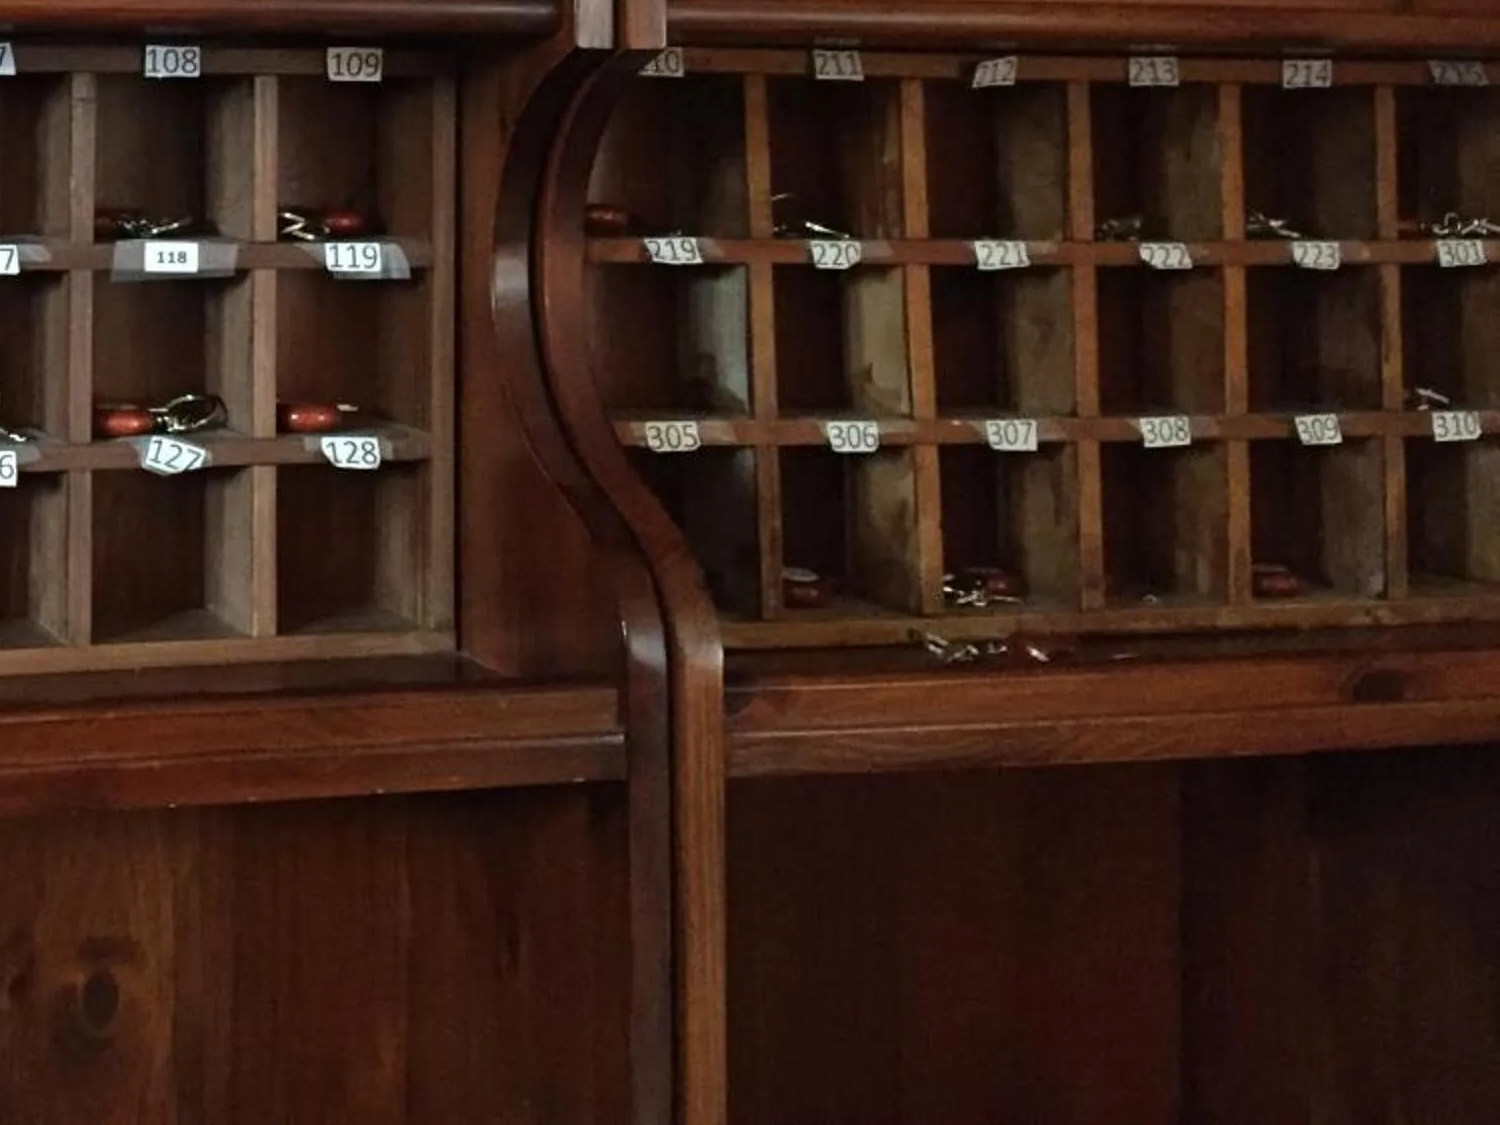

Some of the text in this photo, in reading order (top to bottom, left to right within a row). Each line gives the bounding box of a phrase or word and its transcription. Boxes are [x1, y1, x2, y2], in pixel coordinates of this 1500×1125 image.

[146, 47, 198, 75] 108
[330, 53, 379, 79] 109
[816, 53, 858, 76] 211
[1132, 60, 1177, 83] 213
[1285, 61, 1329, 85] 214
[157, 251, 187, 264] 118
[329, 244, 378, 269] 119
[649, 240, 697, 261] 219
[979, 242, 1026, 267] 221
[1441, 242, 1483, 264] 301
[648, 425, 697, 449] 305
[830, 425, 877, 449] 306
[989, 422, 1032, 446] 307
[1145, 418, 1188, 444] 308
[1300, 418, 1339, 443] 309
[1435, 413, 1477, 438] 310
[149, 440, 200, 470] 127
[325, 440, 377, 465] 128
